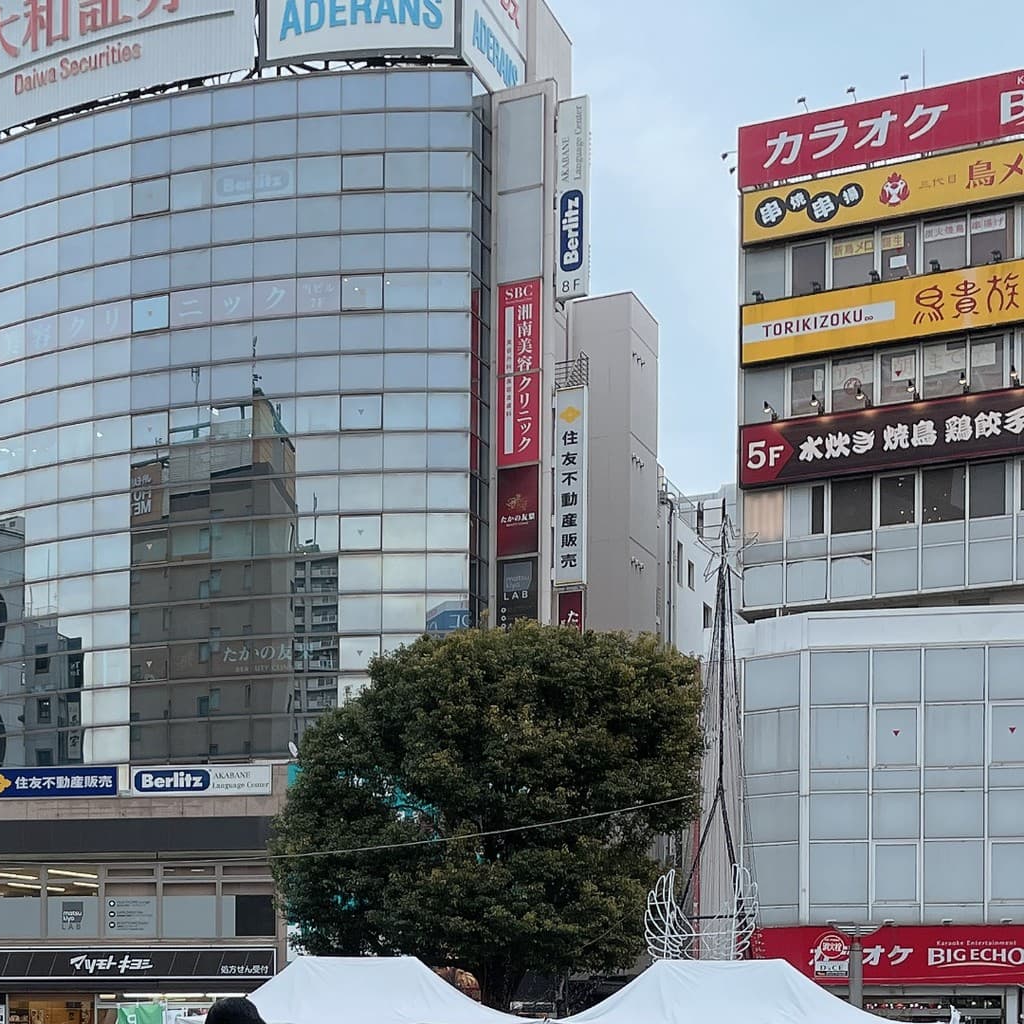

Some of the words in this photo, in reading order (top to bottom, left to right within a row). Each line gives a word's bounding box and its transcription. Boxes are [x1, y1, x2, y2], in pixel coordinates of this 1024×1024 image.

[280, 0, 443, 41] ADERANS
[14, 63, 57, 95] Daiwa
[60, 41, 142, 79] Securities
[574, 105, 584, 135] Center
[762, 103, 949, 169] カラオケ
[561, 136, 570, 183] AKABANE
[574, 137, 584, 181] Language
[562, 196, 580, 266] Berlitz
[505, 284, 533, 301] SBC
[912, 272, 1020, 325] 鳥貴族
[761, 308, 864, 338] TORIKIZOKU
[516, 303, 533, 453] 湘南美容クリニック
[746, 440, 784, 470] 5F
[798, 429, 875, 462] 水炊き
[882, 420, 938, 451] 焼鳥
[561, 430, 579, 569] 住友不動産販売
[504, 590, 528, 601] LAB
[14, 774, 113, 791] 住友不動産販売
[141, 772, 203, 789] Berlitz
[213, 772, 251, 780] AKABANE
[212, 781, 246, 790] Language
[928, 947, 966, 966] BIG
[970, 947, 1024, 966] ECHO
[966, 938, 1018, 946] Entertainment
[70, 954, 155, 974] マツモトキヨシ
[220, 964, 269, 975] 処方せん受付
